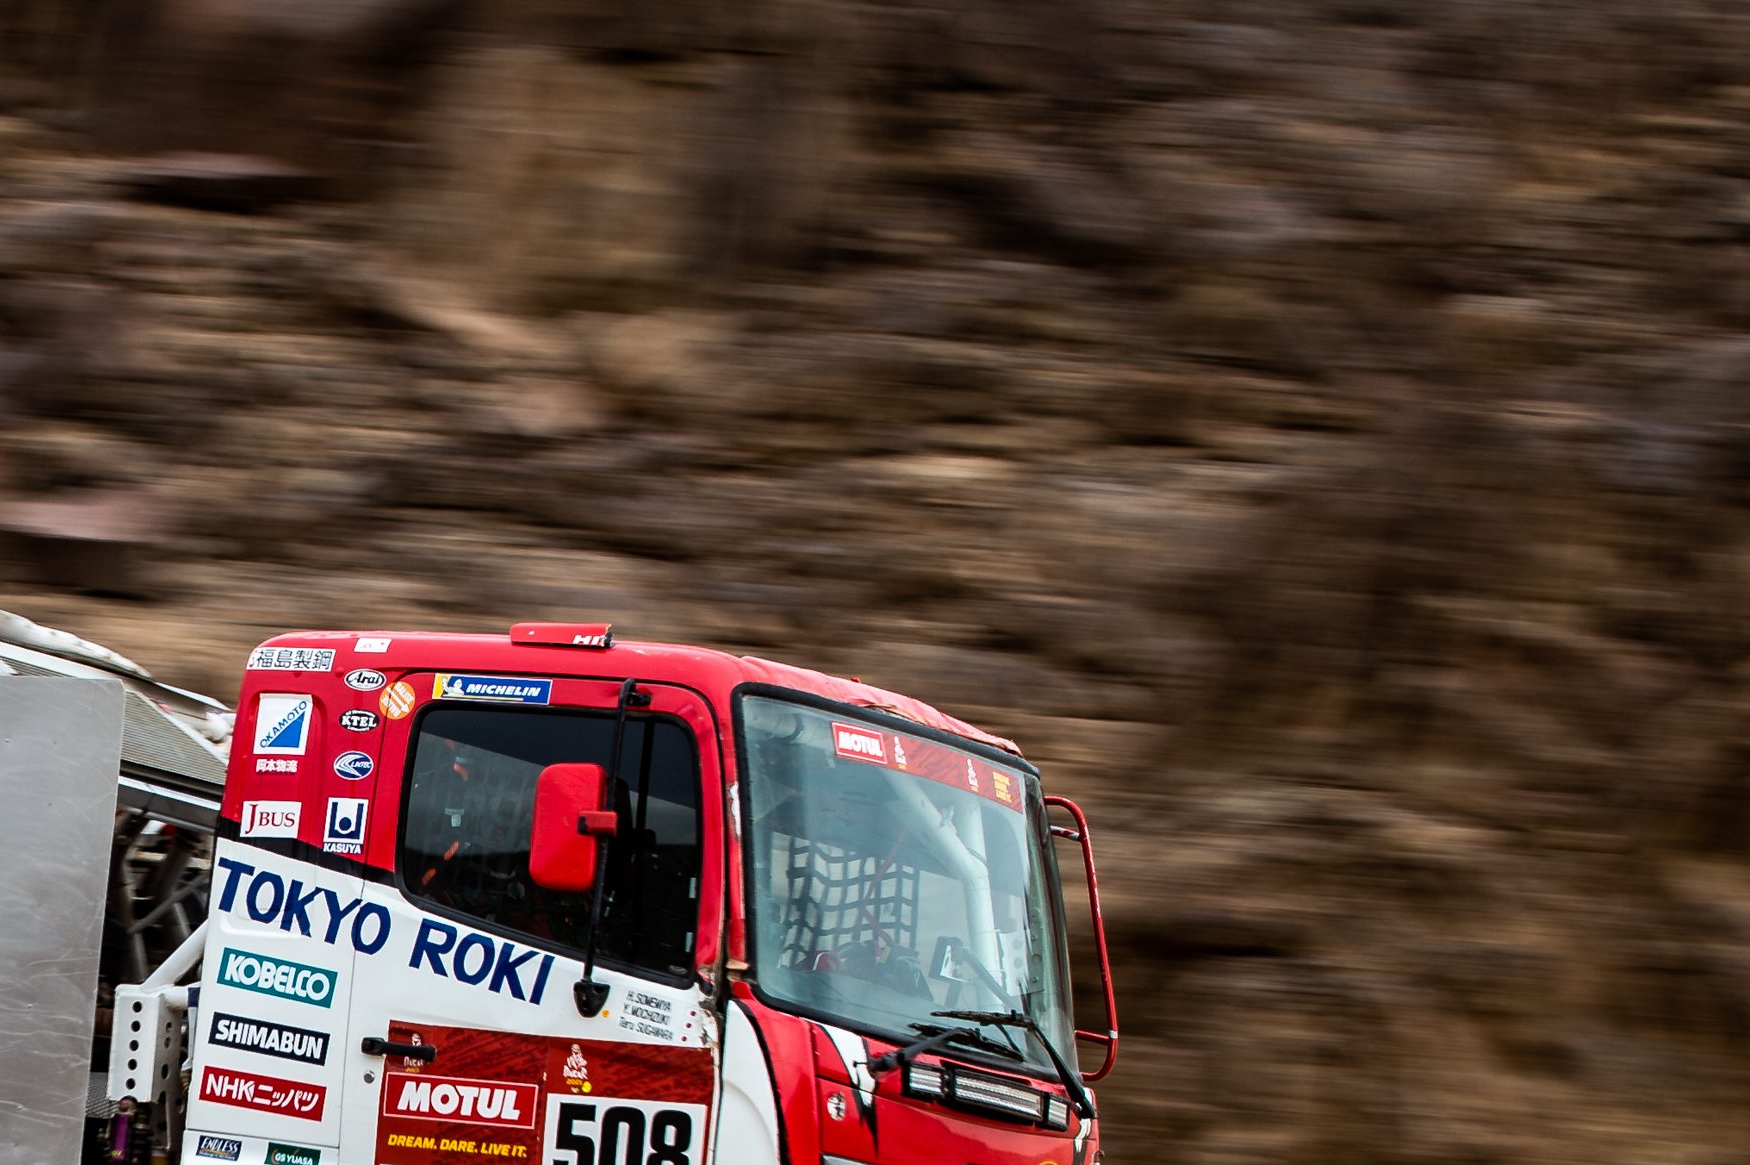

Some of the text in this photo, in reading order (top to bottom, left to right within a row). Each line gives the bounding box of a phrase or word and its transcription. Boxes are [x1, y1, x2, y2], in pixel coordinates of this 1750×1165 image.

[257, 648, 334, 671] 福島製鋼
[351, 670, 381, 686] Arai
[465, 682, 542, 698] MICHELIN
[259, 699, 308, 749] OKAMOTO
[340, 715, 378, 729] KTEL
[838, 730, 883, 757] MOTUL
[256, 758, 299, 774] 岡本物流
[322, 842, 362, 854] KASUYA
[217, 856, 556, 1006] TOKYO ROKI
[223, 954, 332, 1002] KOBELCO
[214, 1018, 325, 1059] SHIMABUN
[397, 1080, 522, 1121] MOTUL
[201, 1136, 240, 1154] ENDLESS
[387, 1133, 528, 1158] DREAM. DARE. LIVE IT.
